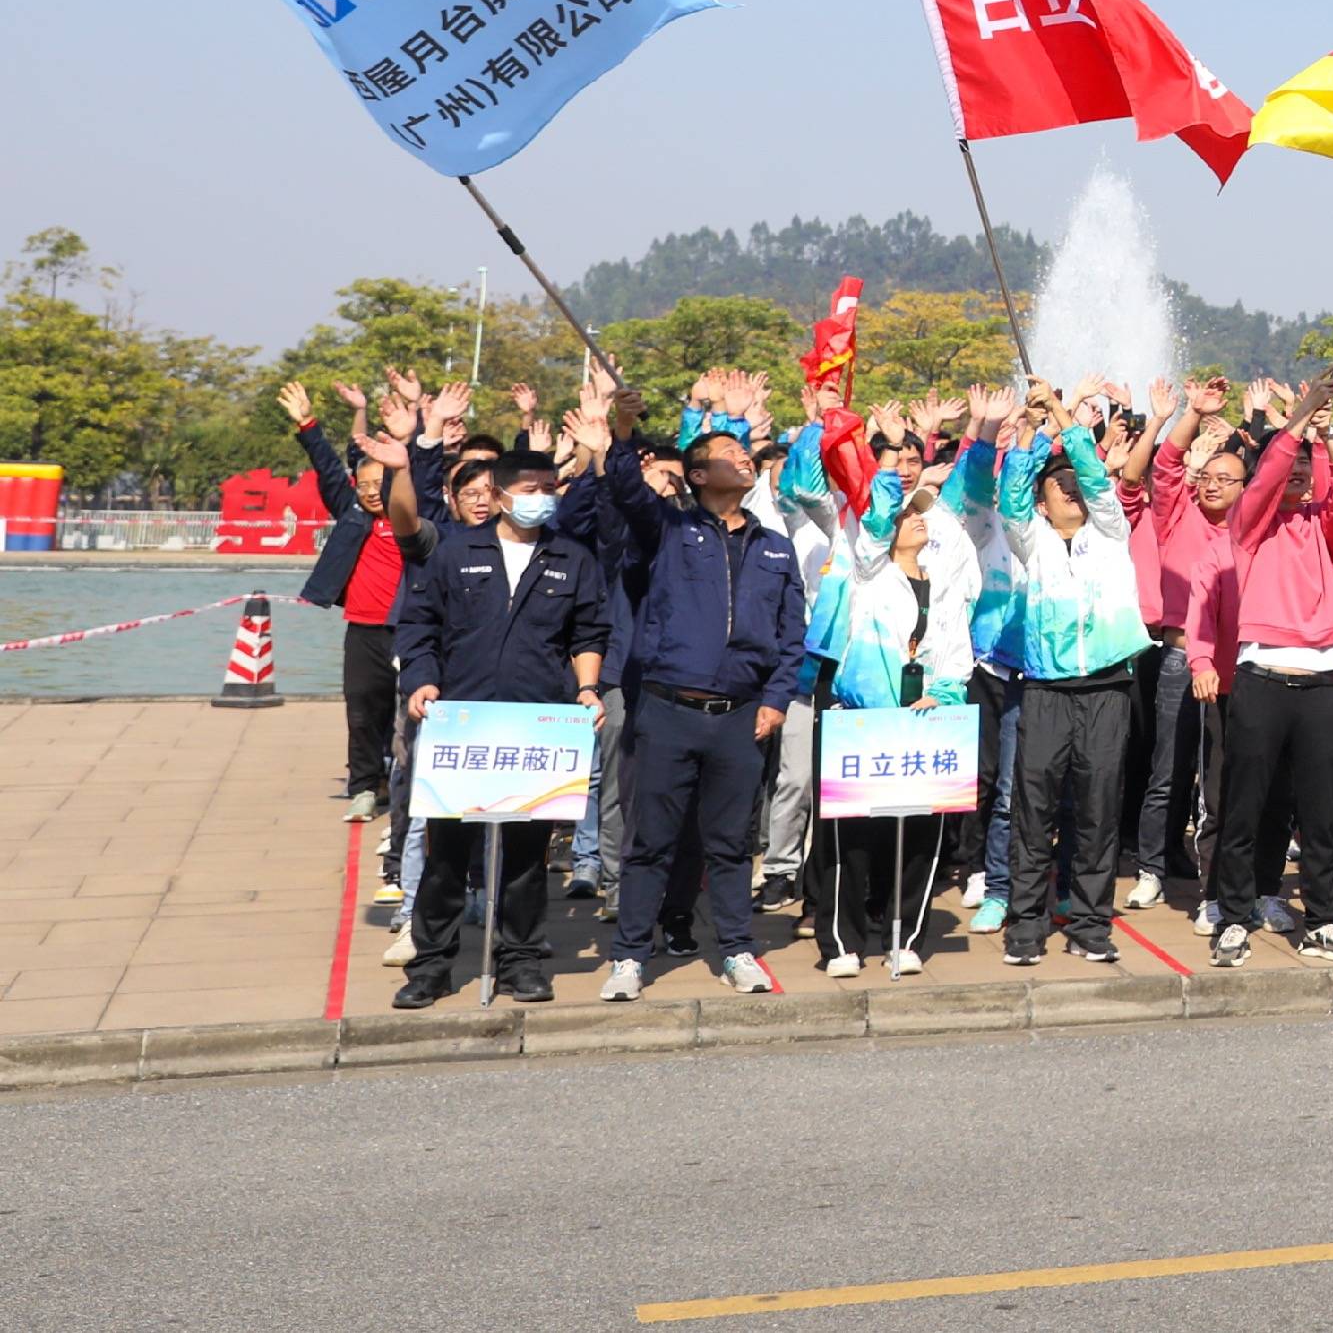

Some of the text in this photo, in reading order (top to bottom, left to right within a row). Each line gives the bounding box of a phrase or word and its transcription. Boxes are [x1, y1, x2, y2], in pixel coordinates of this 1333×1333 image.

[432, 744, 580, 773] 西屋屏蔽门
[841, 748, 959, 778] 日立扶梯
